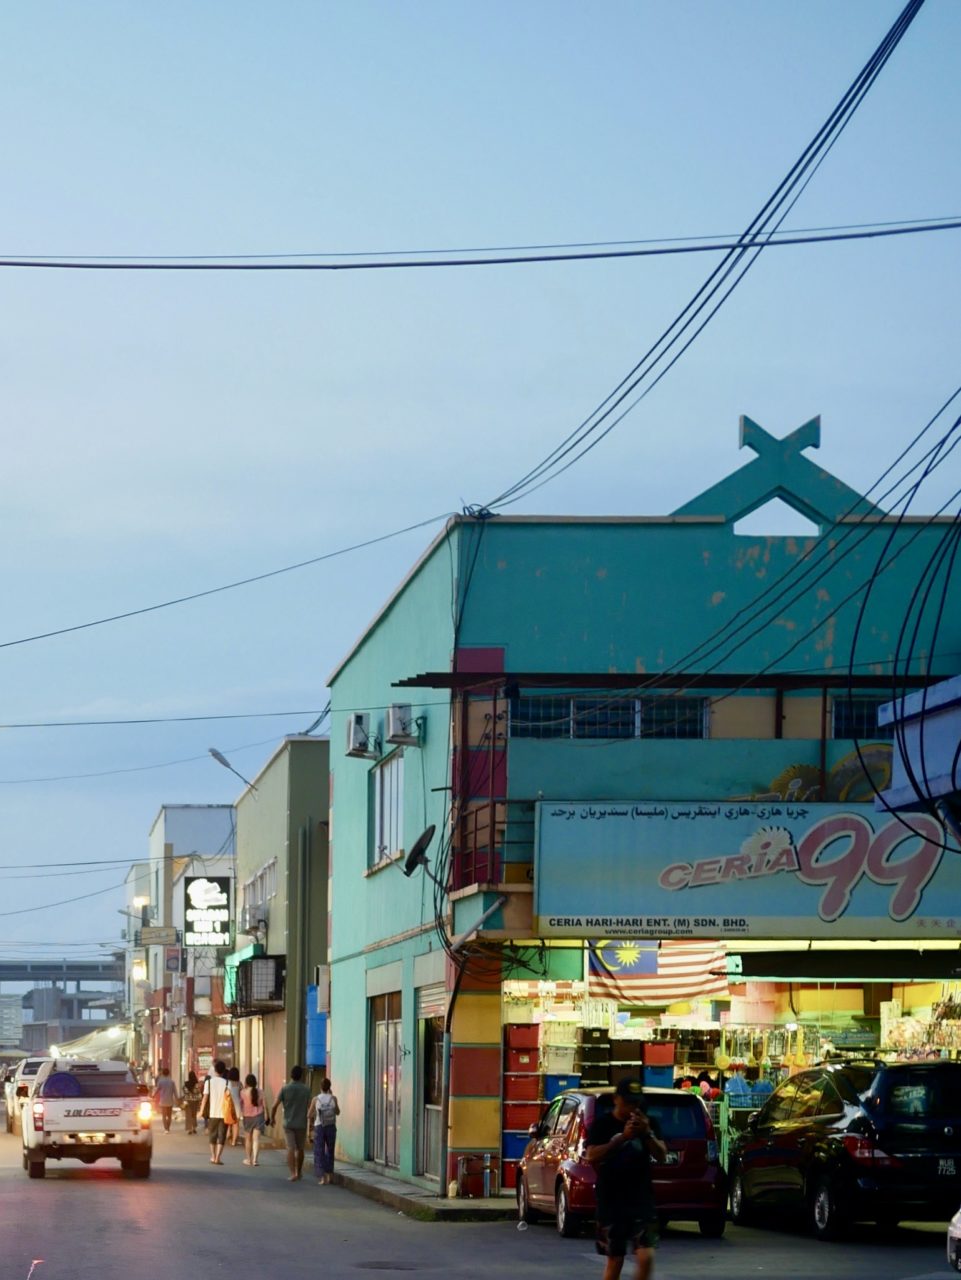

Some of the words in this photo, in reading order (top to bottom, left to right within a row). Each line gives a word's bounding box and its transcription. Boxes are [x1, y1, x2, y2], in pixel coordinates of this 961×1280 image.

[794, 811, 947, 923] 99
[549, 918, 583, 927] CERIA
[586, 918, 642, 927] HARI-HARI
[646, 918, 670, 927] ENT.
[673, 918, 691, 929] (M)
[693, 918, 719, 927] SDN.
[722, 918, 749, 927] BHD.
[605, 928, 693, 936] www.ceriagroup.com
[85, 1108, 122, 1117] POWER
